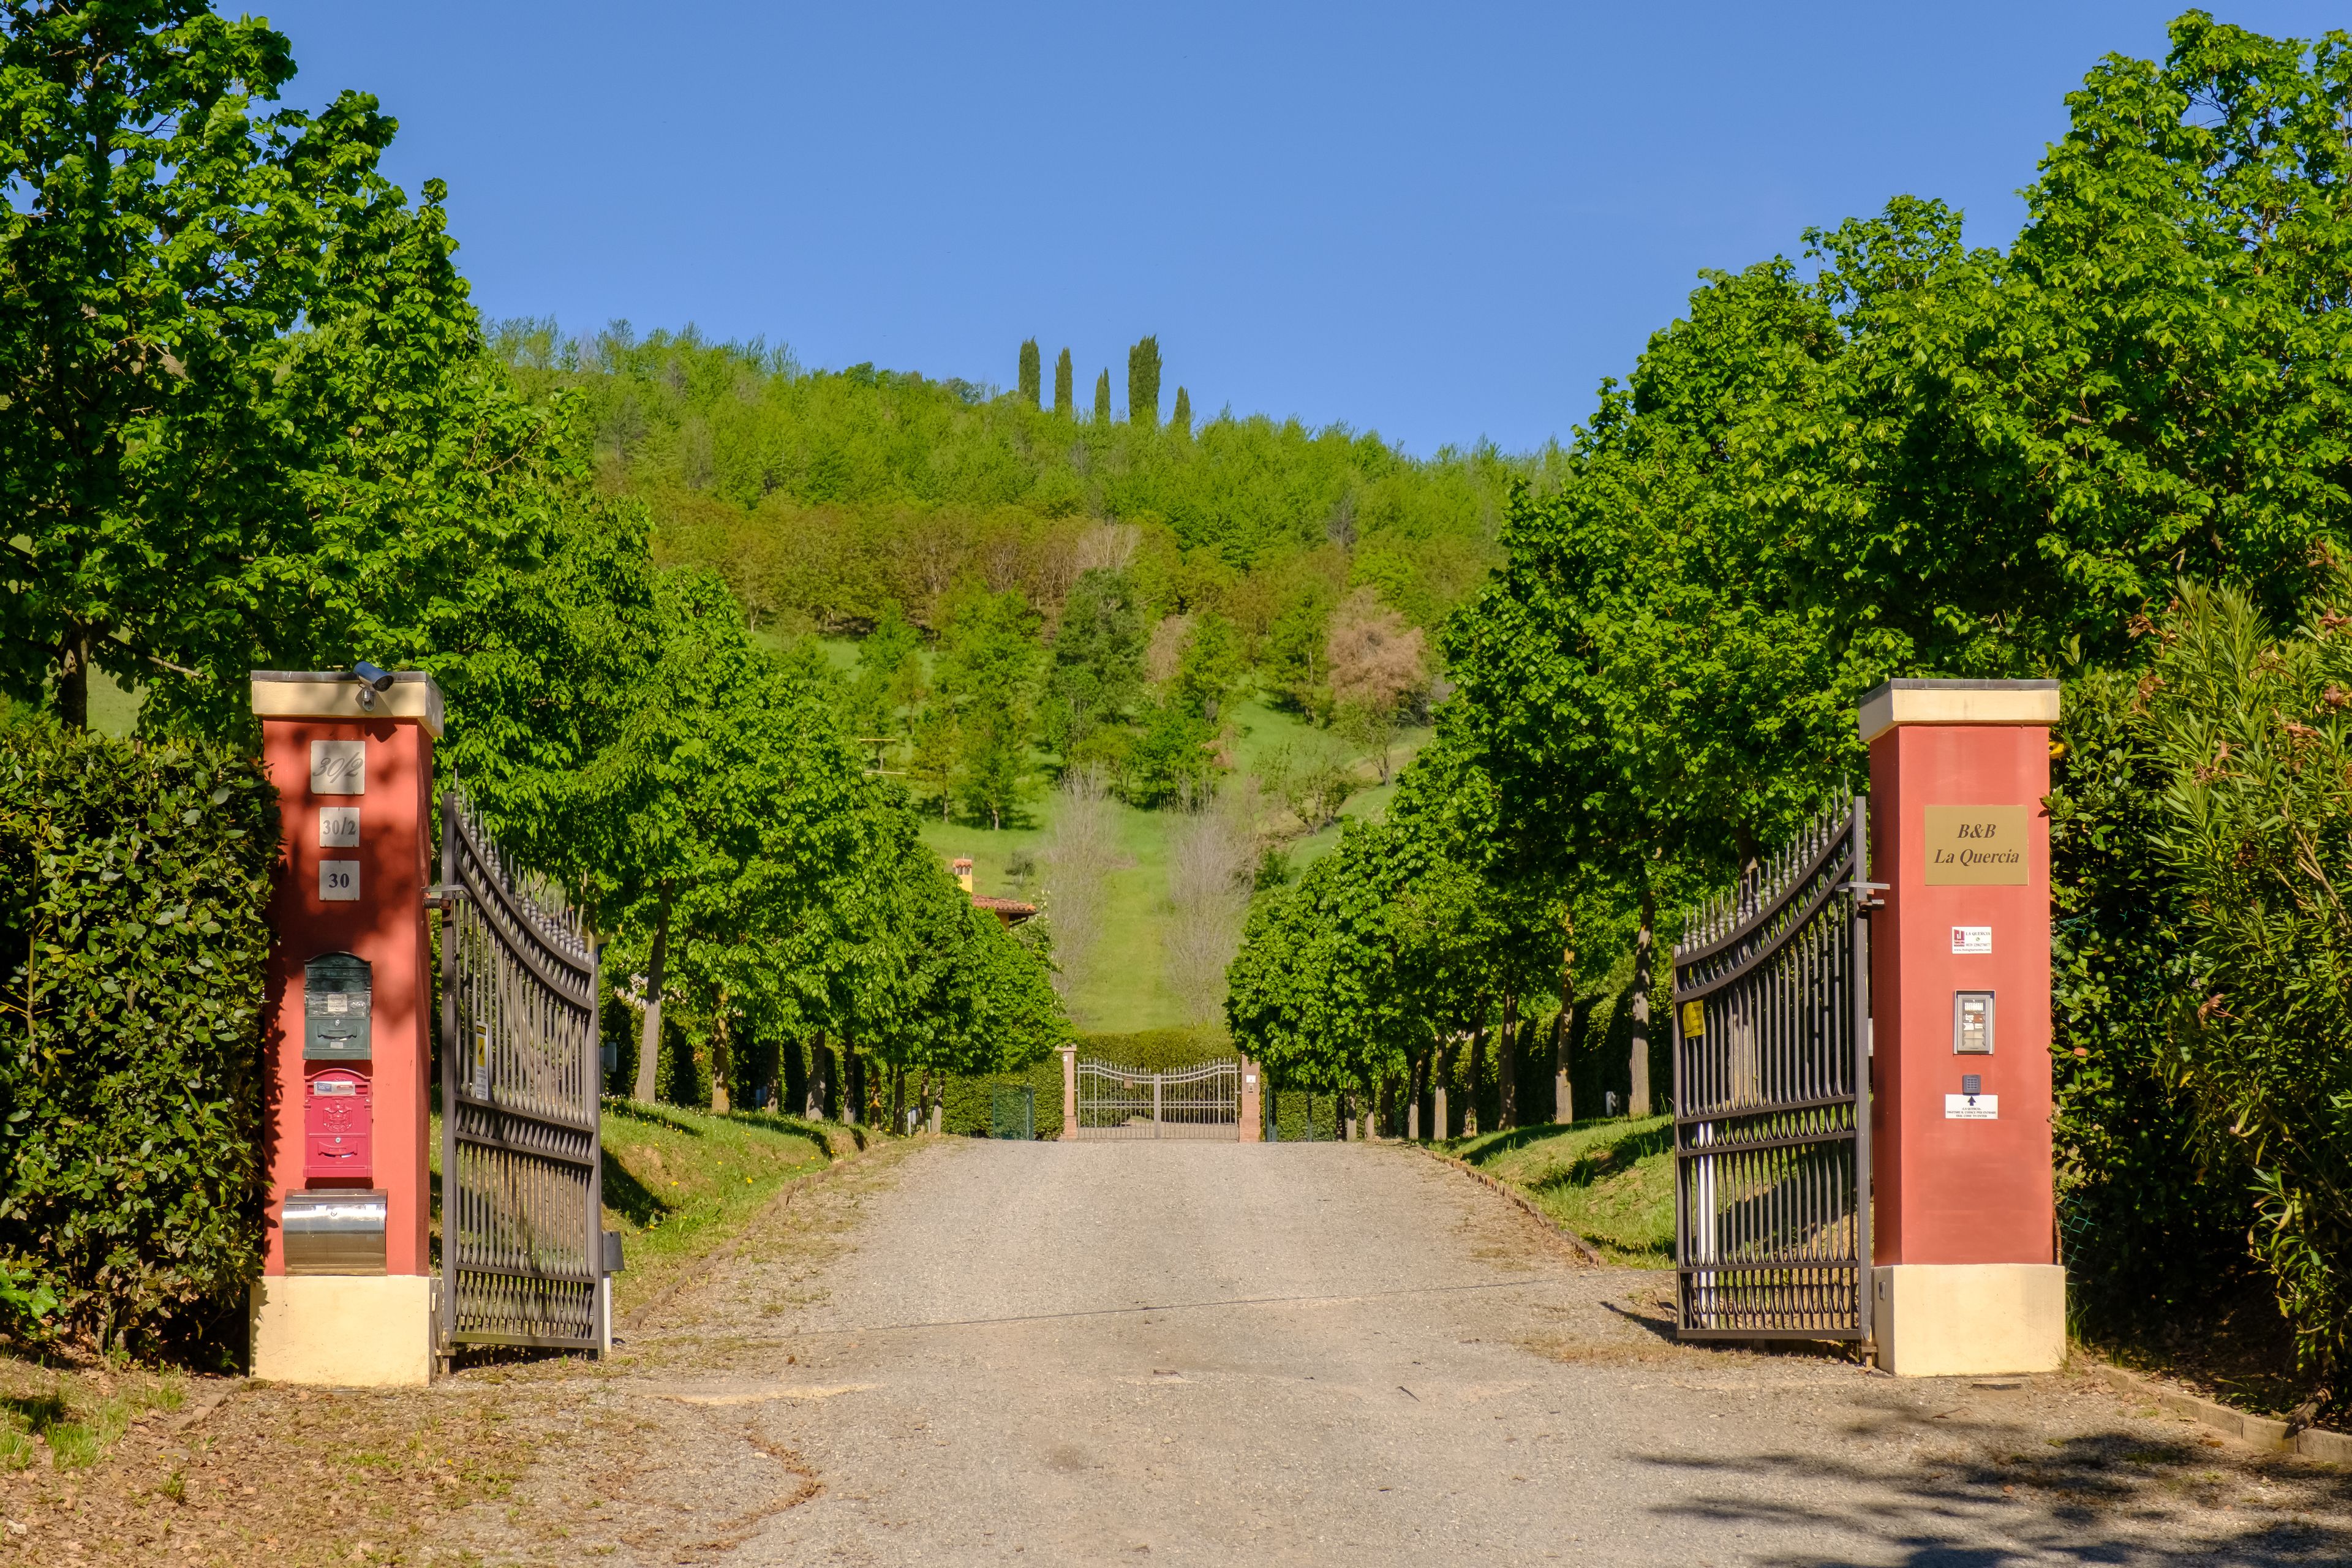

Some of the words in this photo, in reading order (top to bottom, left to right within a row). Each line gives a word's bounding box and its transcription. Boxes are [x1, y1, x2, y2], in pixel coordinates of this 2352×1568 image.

[312, 752, 364, 783] 30/2
[323, 817, 356, 835] 30/2
[1957, 823, 1997, 839] B&B
[1934, 849, 1955, 864] La
[1960, 848, 2019, 867] Quercia
[328, 873, 350, 888] 30
